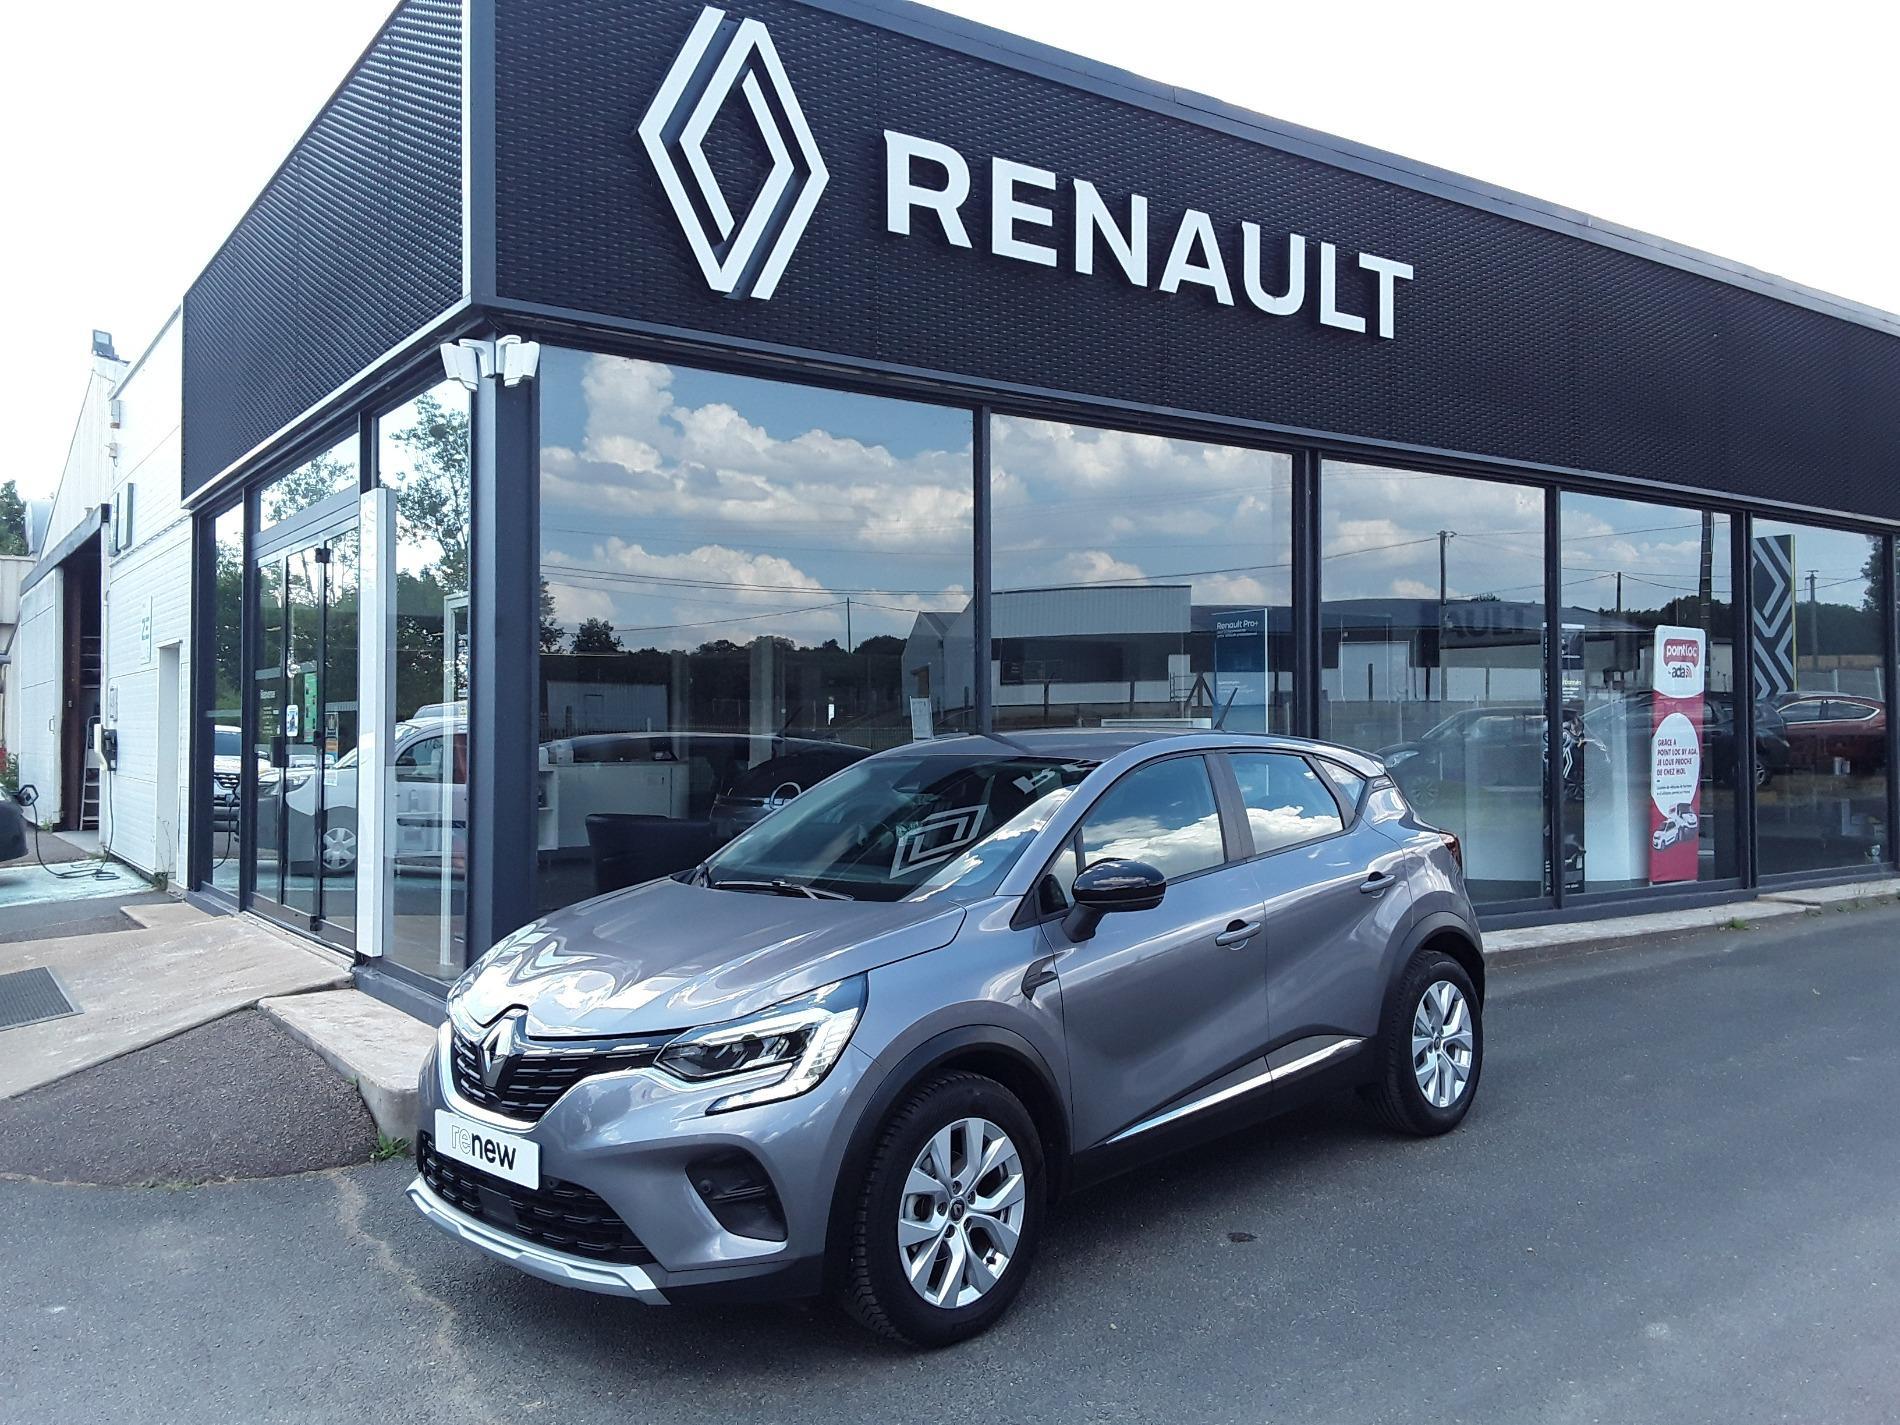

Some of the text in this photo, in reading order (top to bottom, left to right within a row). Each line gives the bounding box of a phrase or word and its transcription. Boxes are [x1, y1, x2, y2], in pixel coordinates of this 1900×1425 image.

[883, 129, 1414, 339] RENAULT
[1216, 619, 1243, 630] Renault
[451, 1125, 516, 1171] renew
